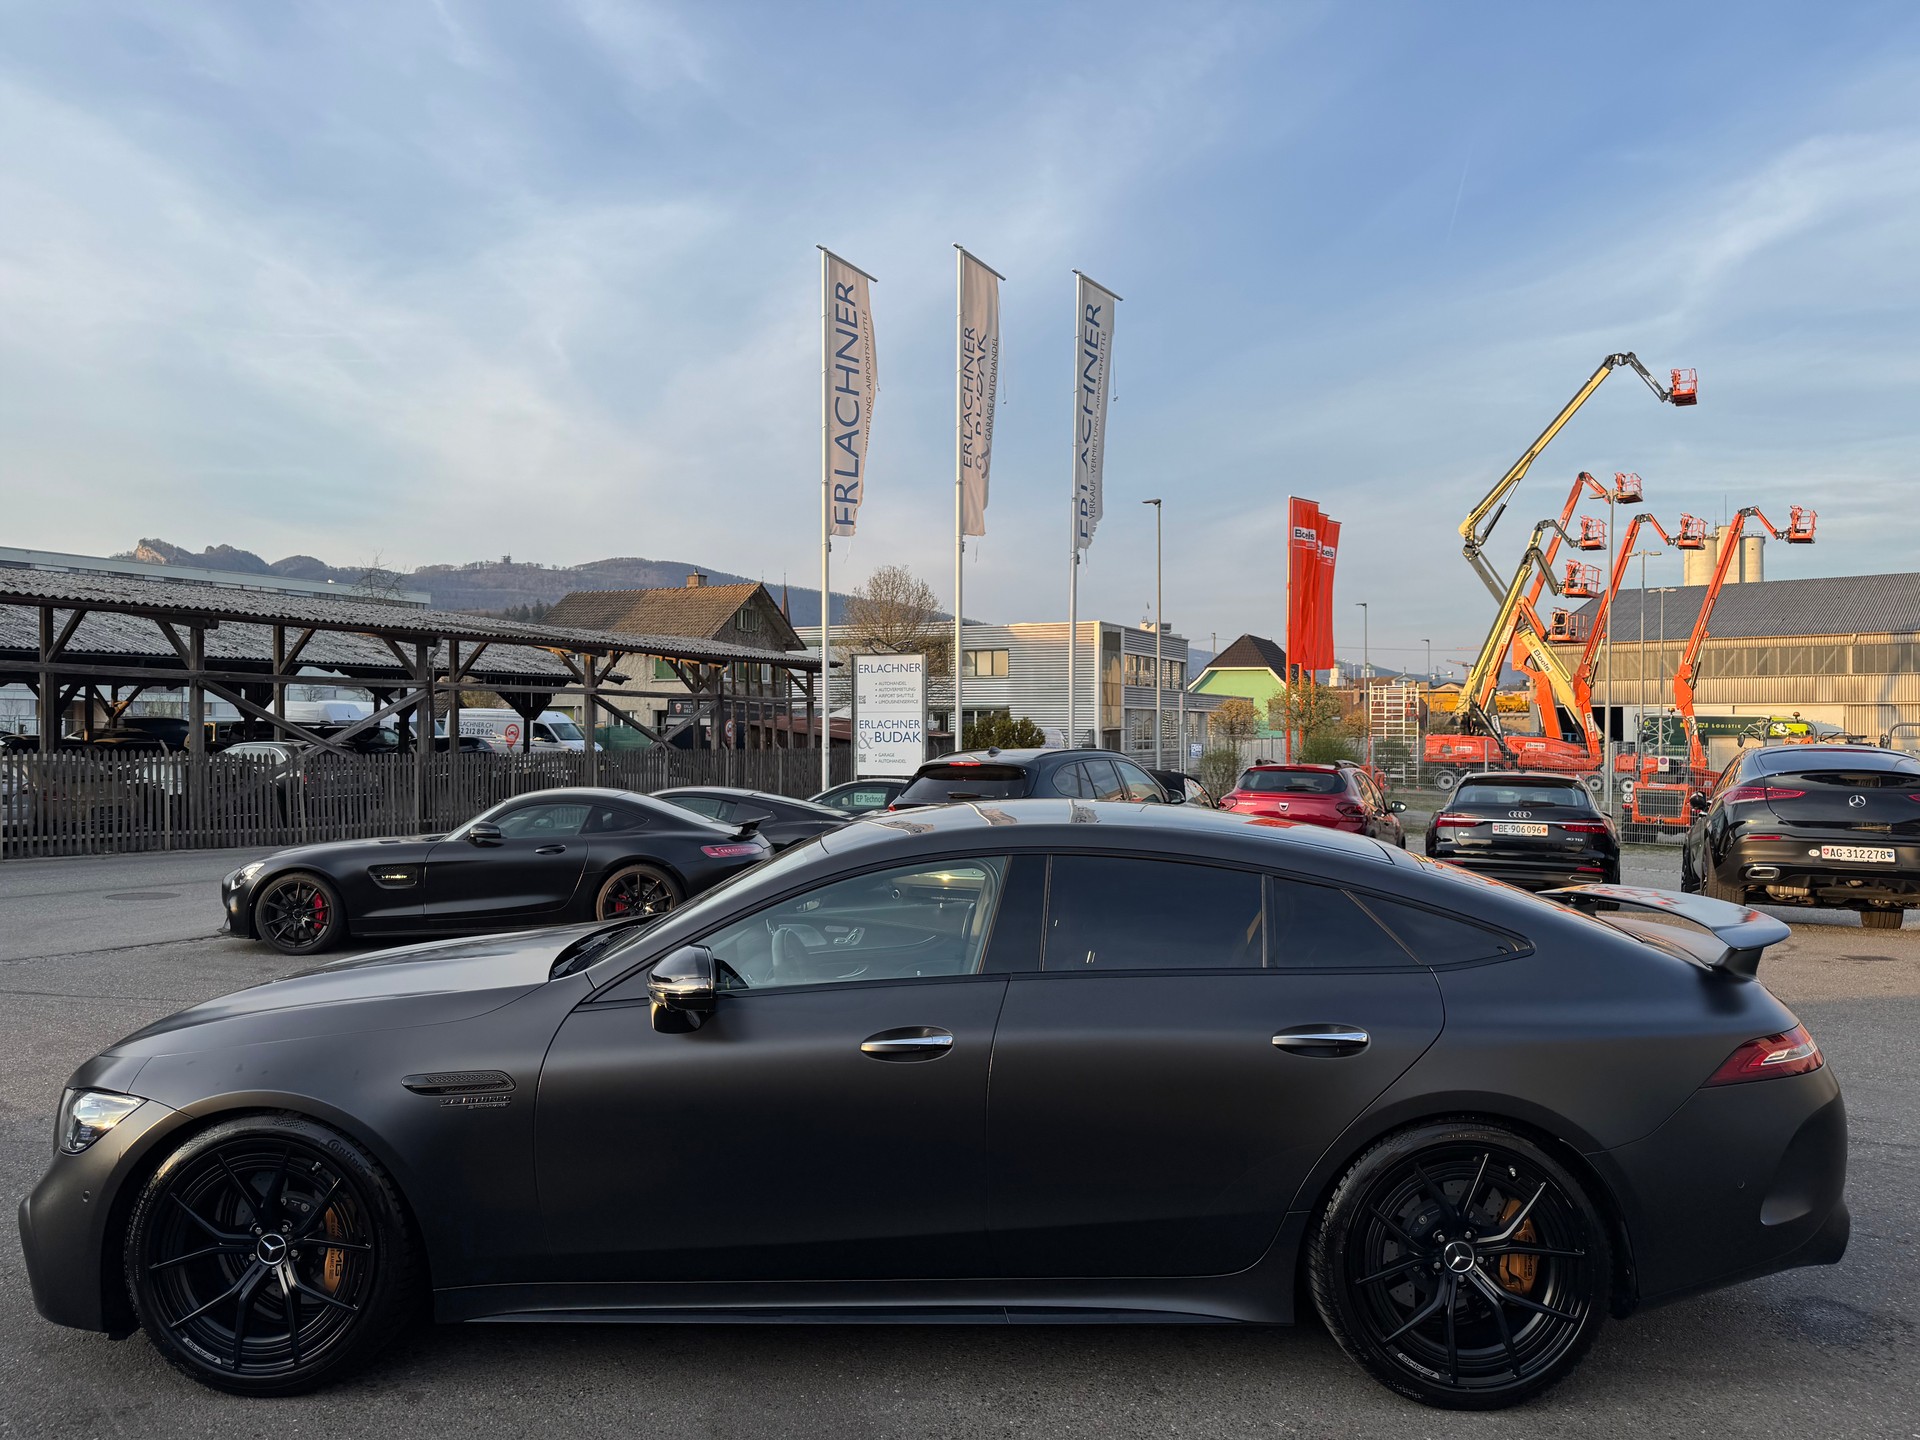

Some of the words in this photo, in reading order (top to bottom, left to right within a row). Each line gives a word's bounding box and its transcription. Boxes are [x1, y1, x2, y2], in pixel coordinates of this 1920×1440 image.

[988, 336, 999, 403] AUTOHANDEL
[963, 327, 975, 468] ERLACHNER
[985, 402, 996, 441] GARAGE
[1088, 479, 1097, 519] VERKAUF
[858, 663, 922, 674] ERLACHNER
[858, 730, 874, 750] &
[874, 731, 922, 743] BUDAK
[859, 719, 921, 729] ERLACHNER
